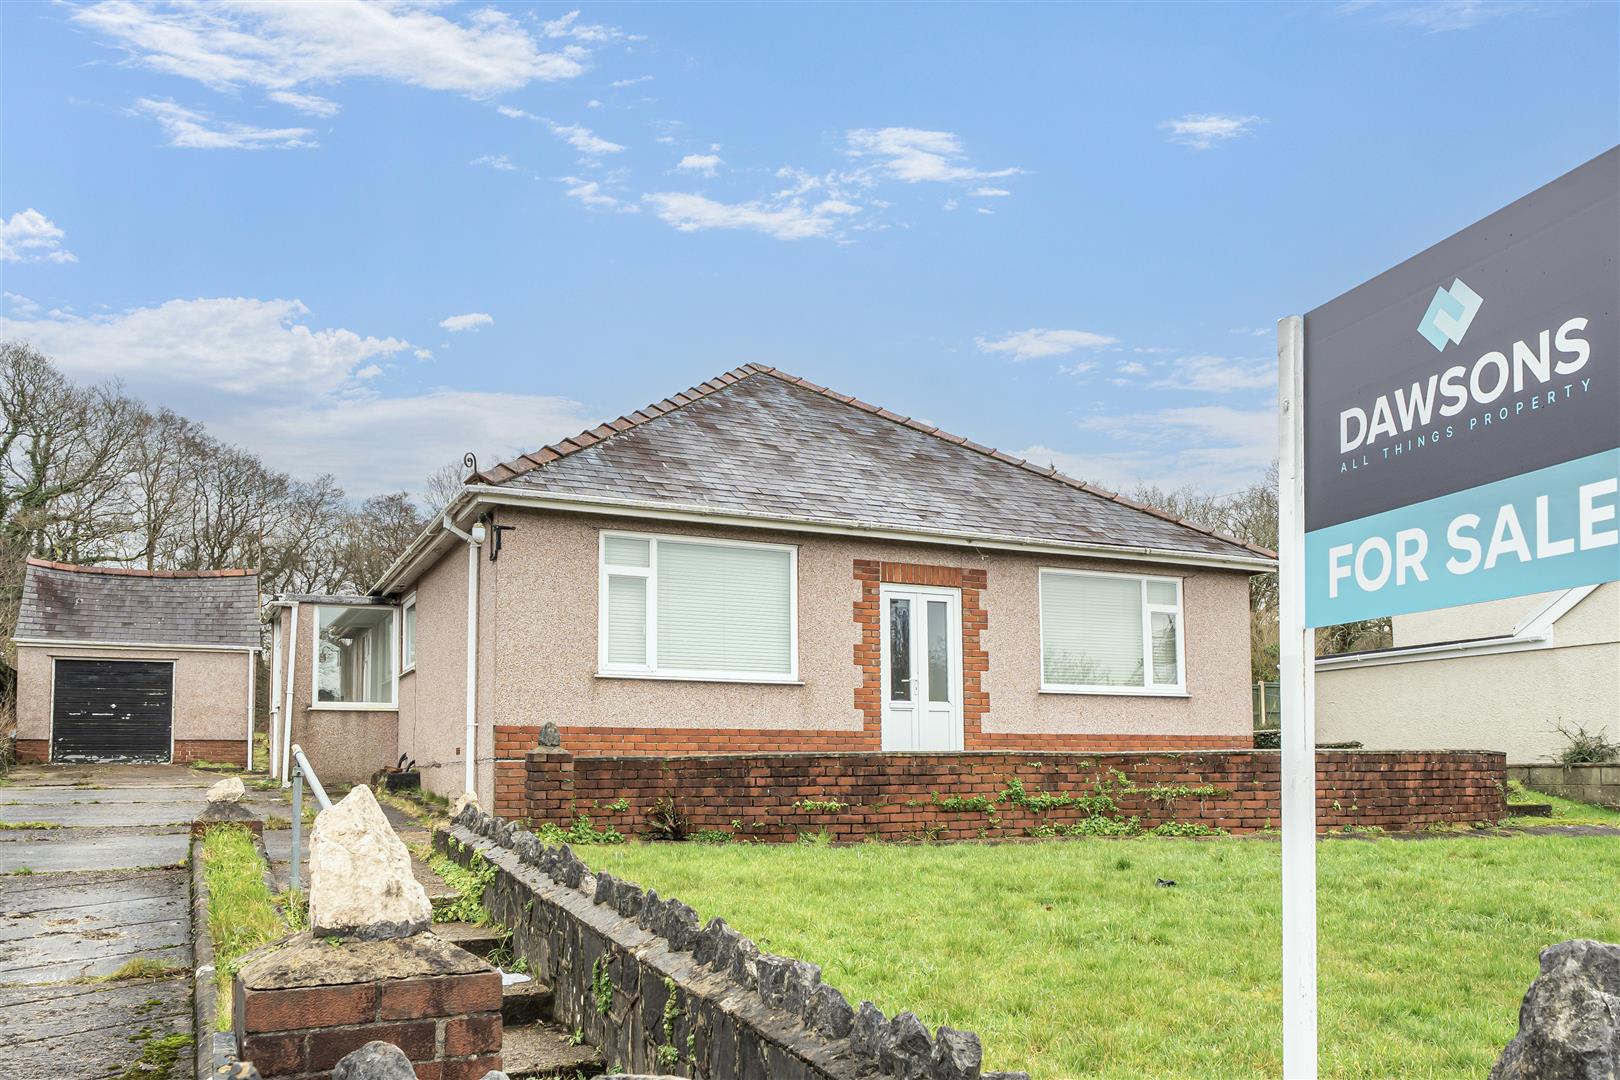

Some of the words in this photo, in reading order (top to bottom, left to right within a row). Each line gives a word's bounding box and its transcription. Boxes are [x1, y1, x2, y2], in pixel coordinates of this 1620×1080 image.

[1339, 317, 1591, 454] DAWSONS
[1340, 456, 1369, 473] ALL
[1383, 425, 1454, 459] THINGS
[1469, 377, 1592, 431] PROPERTY
[1328, 527, 1429, 599] FOR
[1446, 477, 1619, 575] SALE
